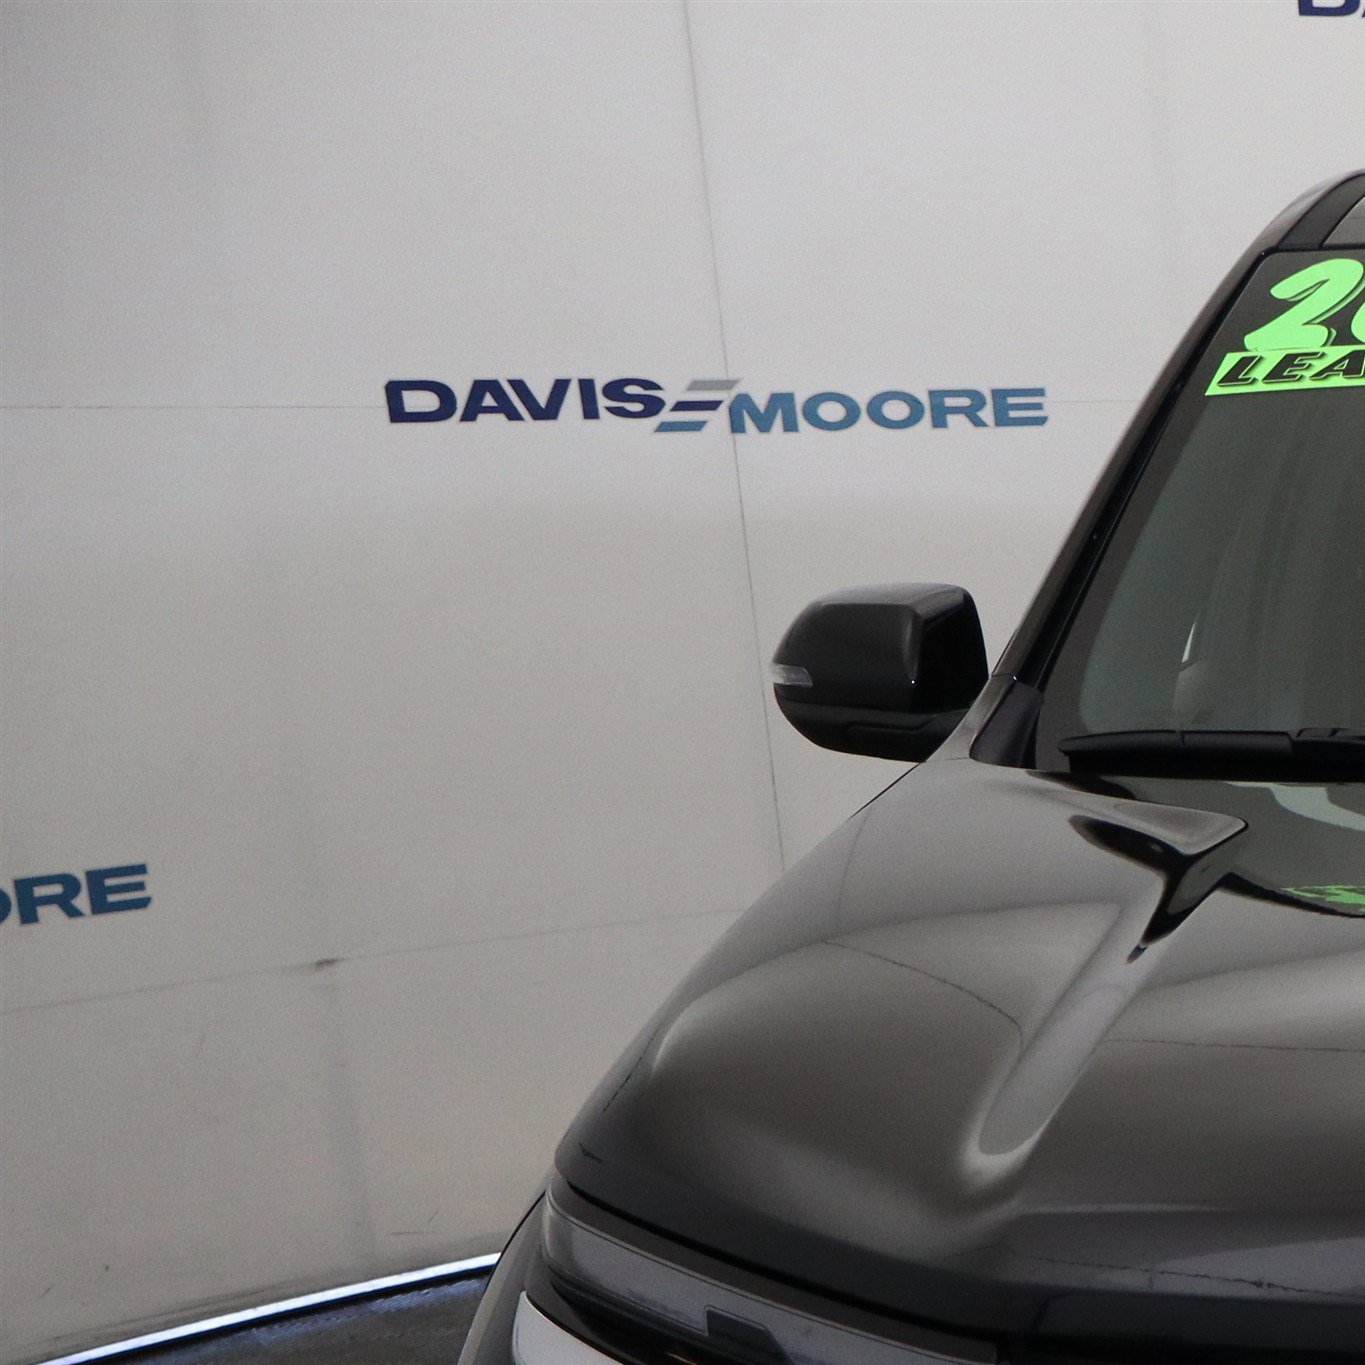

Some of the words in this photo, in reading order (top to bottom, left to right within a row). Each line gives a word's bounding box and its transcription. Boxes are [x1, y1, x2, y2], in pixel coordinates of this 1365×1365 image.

[385, 378, 666, 423] DAVIS
[727, 387, 1049, 434] MOORE
[0, 863, 152, 925] RE
